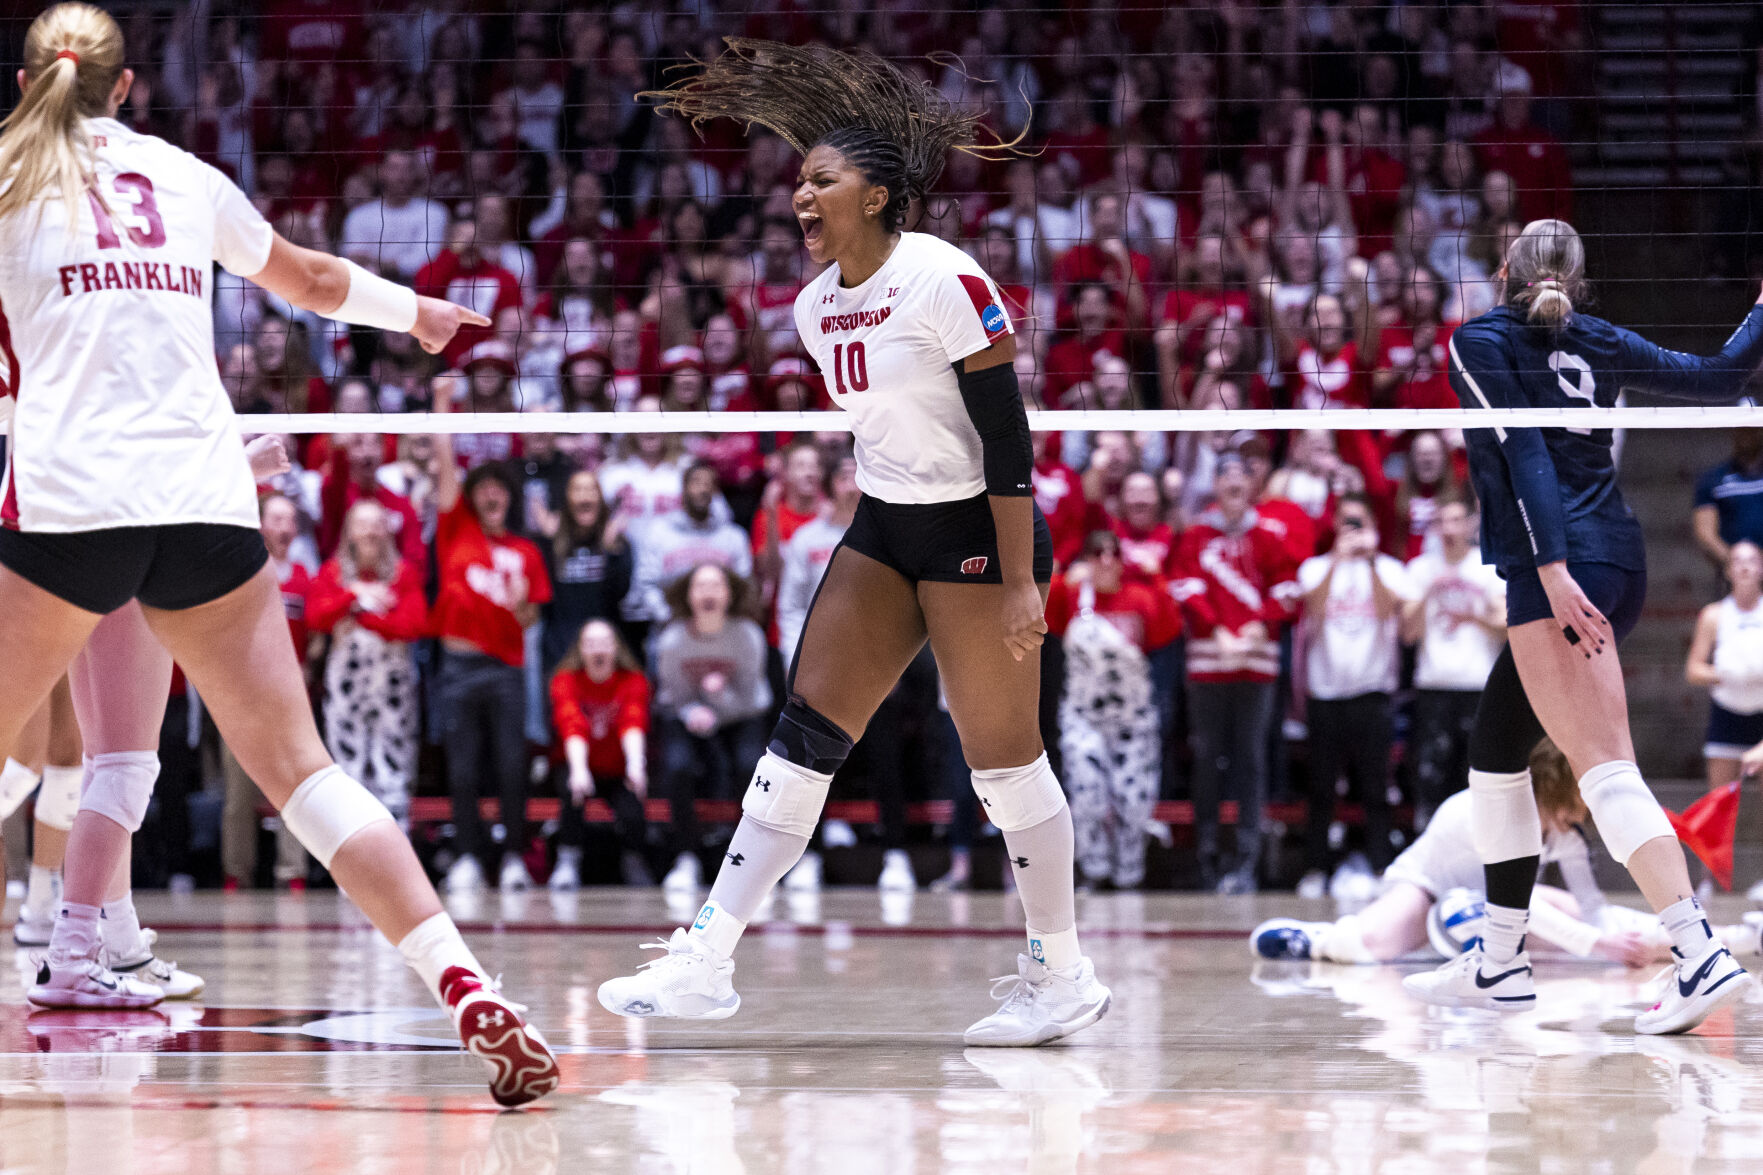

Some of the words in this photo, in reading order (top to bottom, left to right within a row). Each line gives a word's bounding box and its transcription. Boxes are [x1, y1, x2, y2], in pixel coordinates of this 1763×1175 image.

[82, 172, 166, 249] 13
[58, 261, 202, 298] FRANKLIN
[820, 306, 891, 335] WISCONSIN
[986, 313, 1004, 328] NCAA
[833, 341, 869, 395] 10
